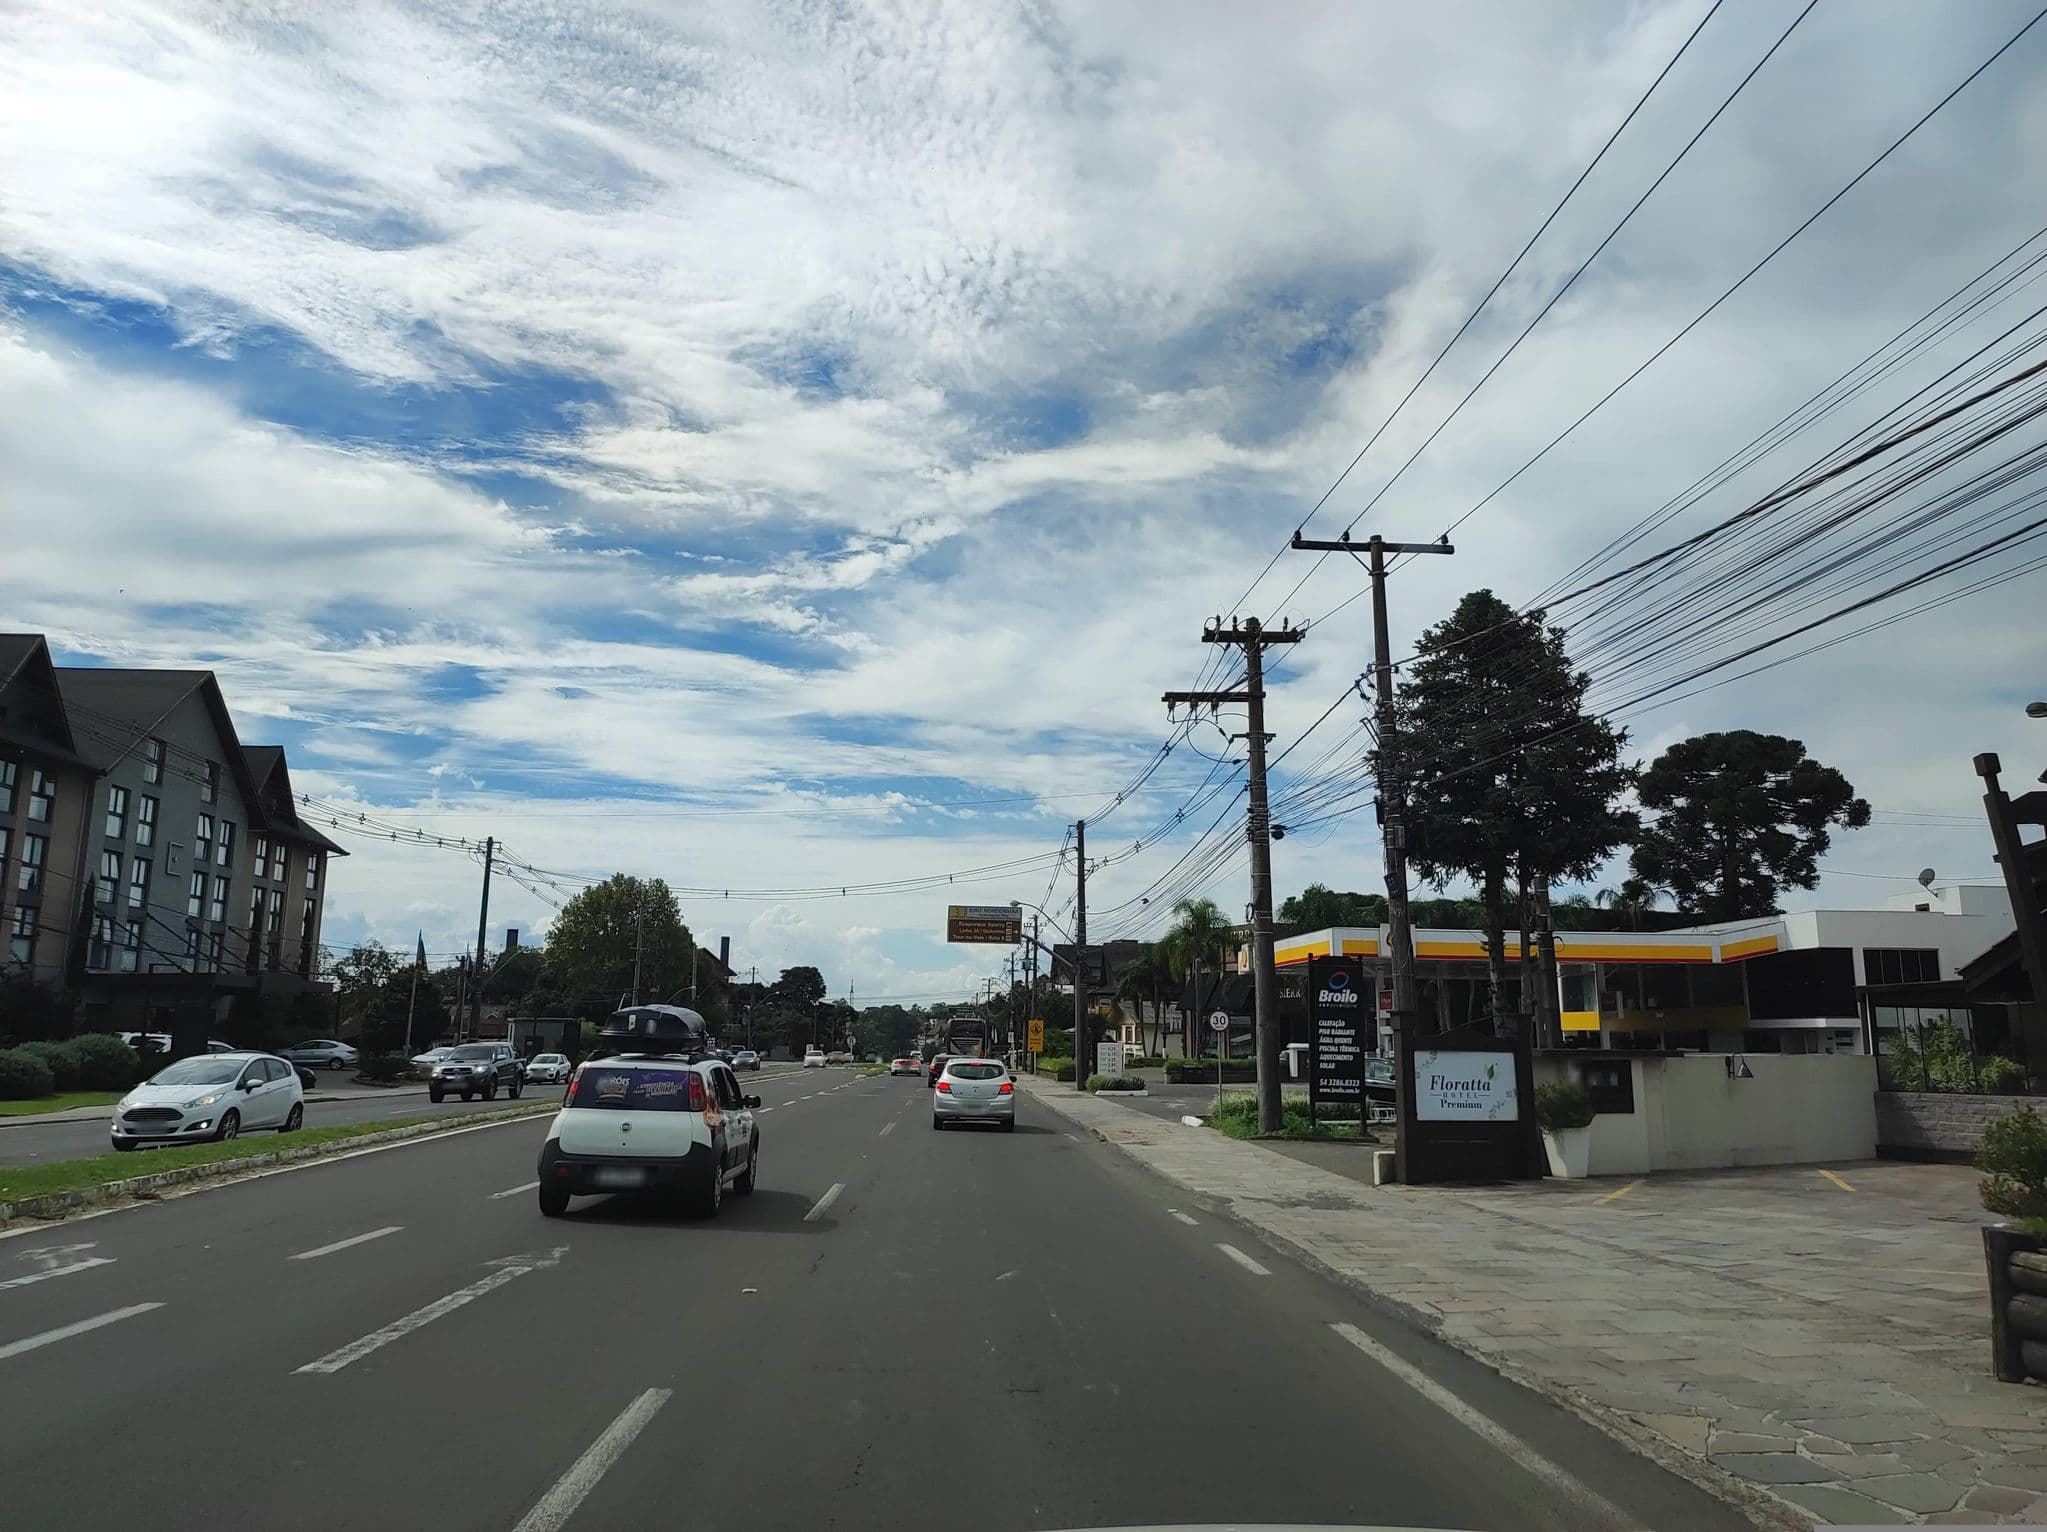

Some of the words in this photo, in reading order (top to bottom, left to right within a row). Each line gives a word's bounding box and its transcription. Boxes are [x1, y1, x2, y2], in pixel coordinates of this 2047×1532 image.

[1318, 989, 1358, 1003] Broilo
[1212, 1015, 1226, 1025] 30
[1319, 1035, 1333, 1043] ÁGUA
[1339, 1045, 1360, 1053] TÉRMICA
[1319, 1078, 1328, 1086] 54
[1429, 1074, 1491, 1091] Floratta
[1440, 1099, 1482, 1109] Premium
